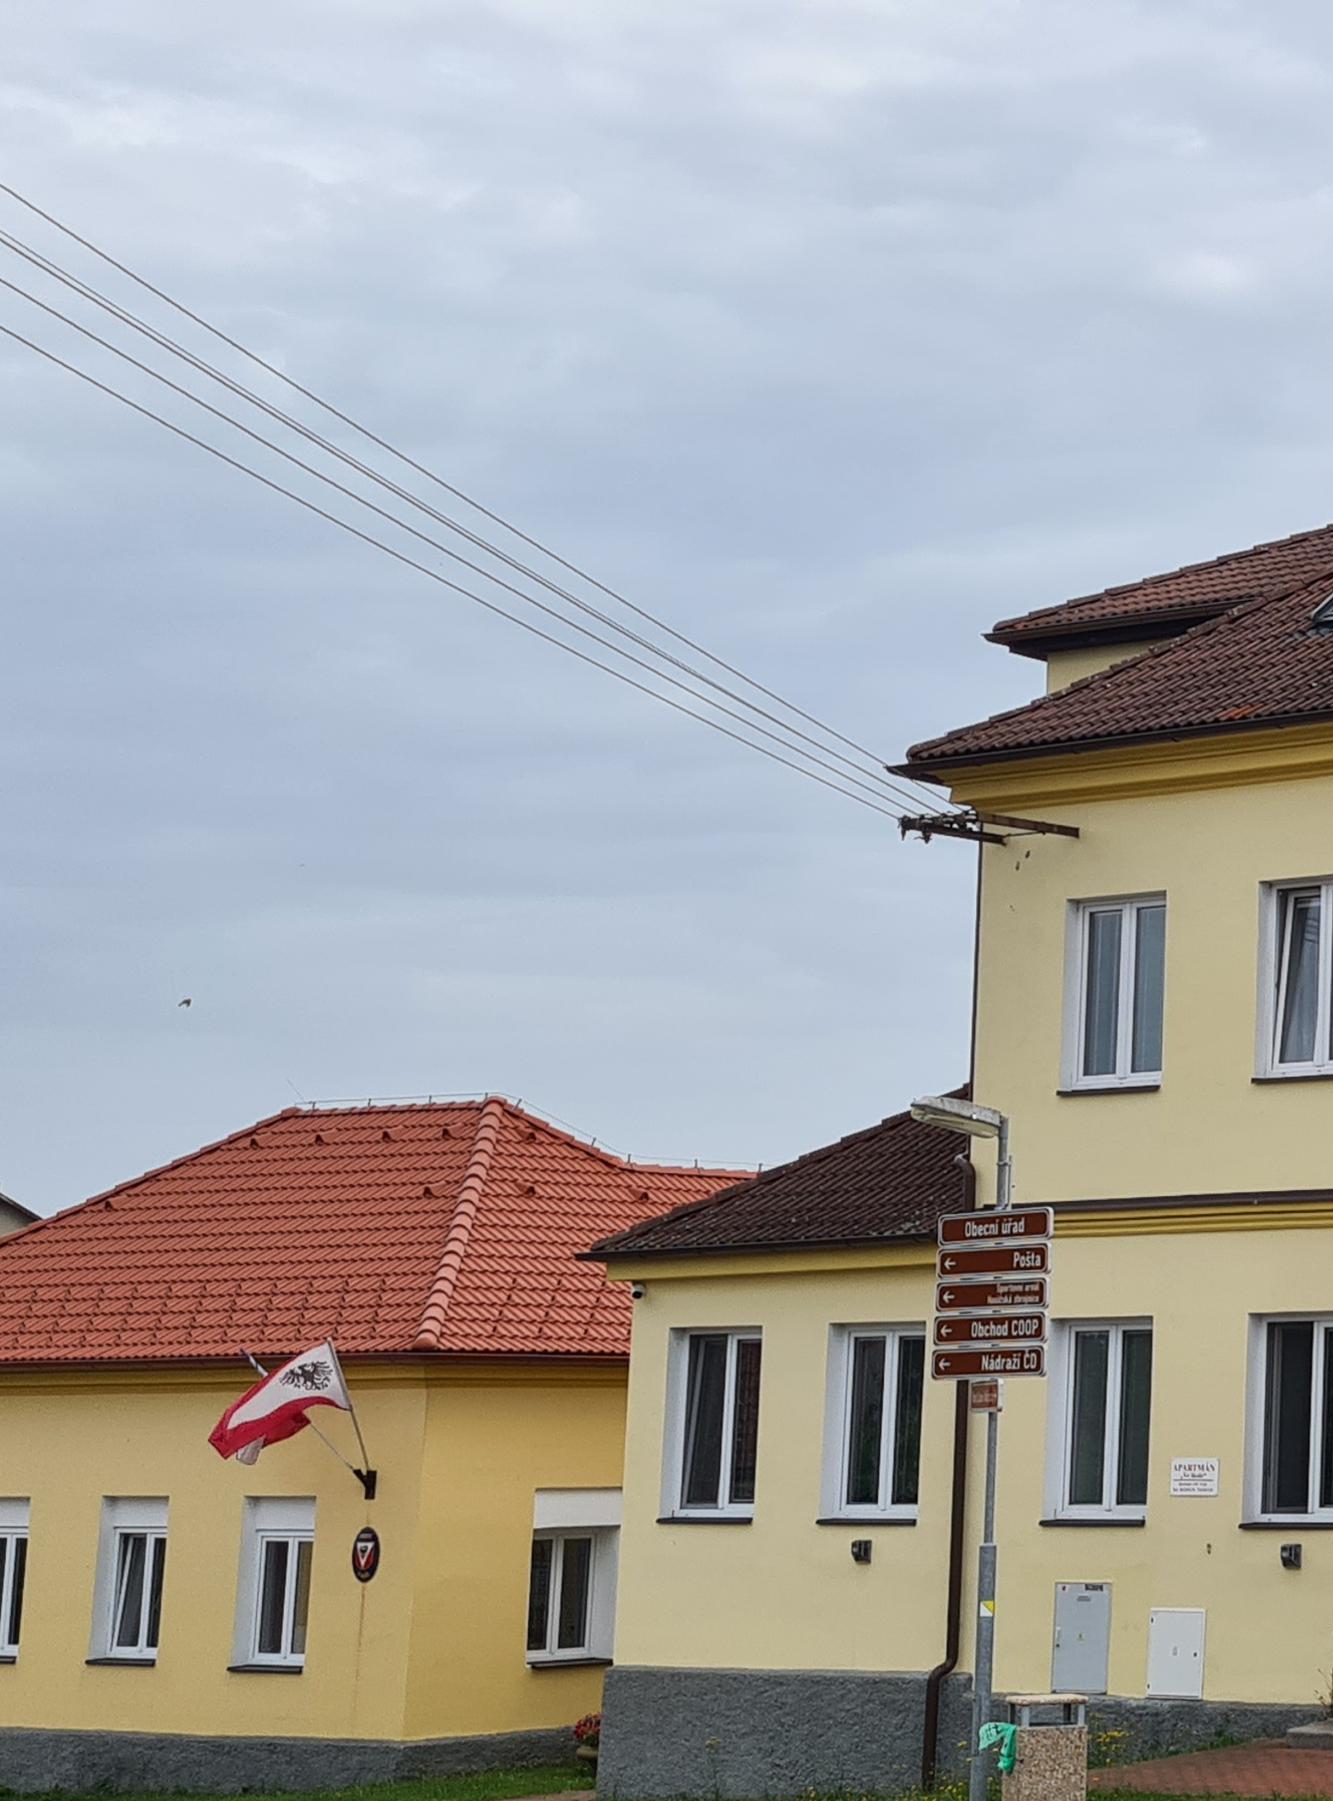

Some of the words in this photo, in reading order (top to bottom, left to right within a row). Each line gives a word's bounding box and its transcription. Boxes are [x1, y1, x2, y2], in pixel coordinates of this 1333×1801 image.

[965, 1220, 998, 1238] Obecní
[1001, 1217, 1025, 1234] úřad
[1013, 1251, 1041, 1268] Pošta
[971, 1320, 1008, 1338] Obchod
[1011, 1319, 1039, 1336] COOP
[981, 1352, 1020, 1371] Nádraží
[1023, 1349, 1037, 1369] ČD
